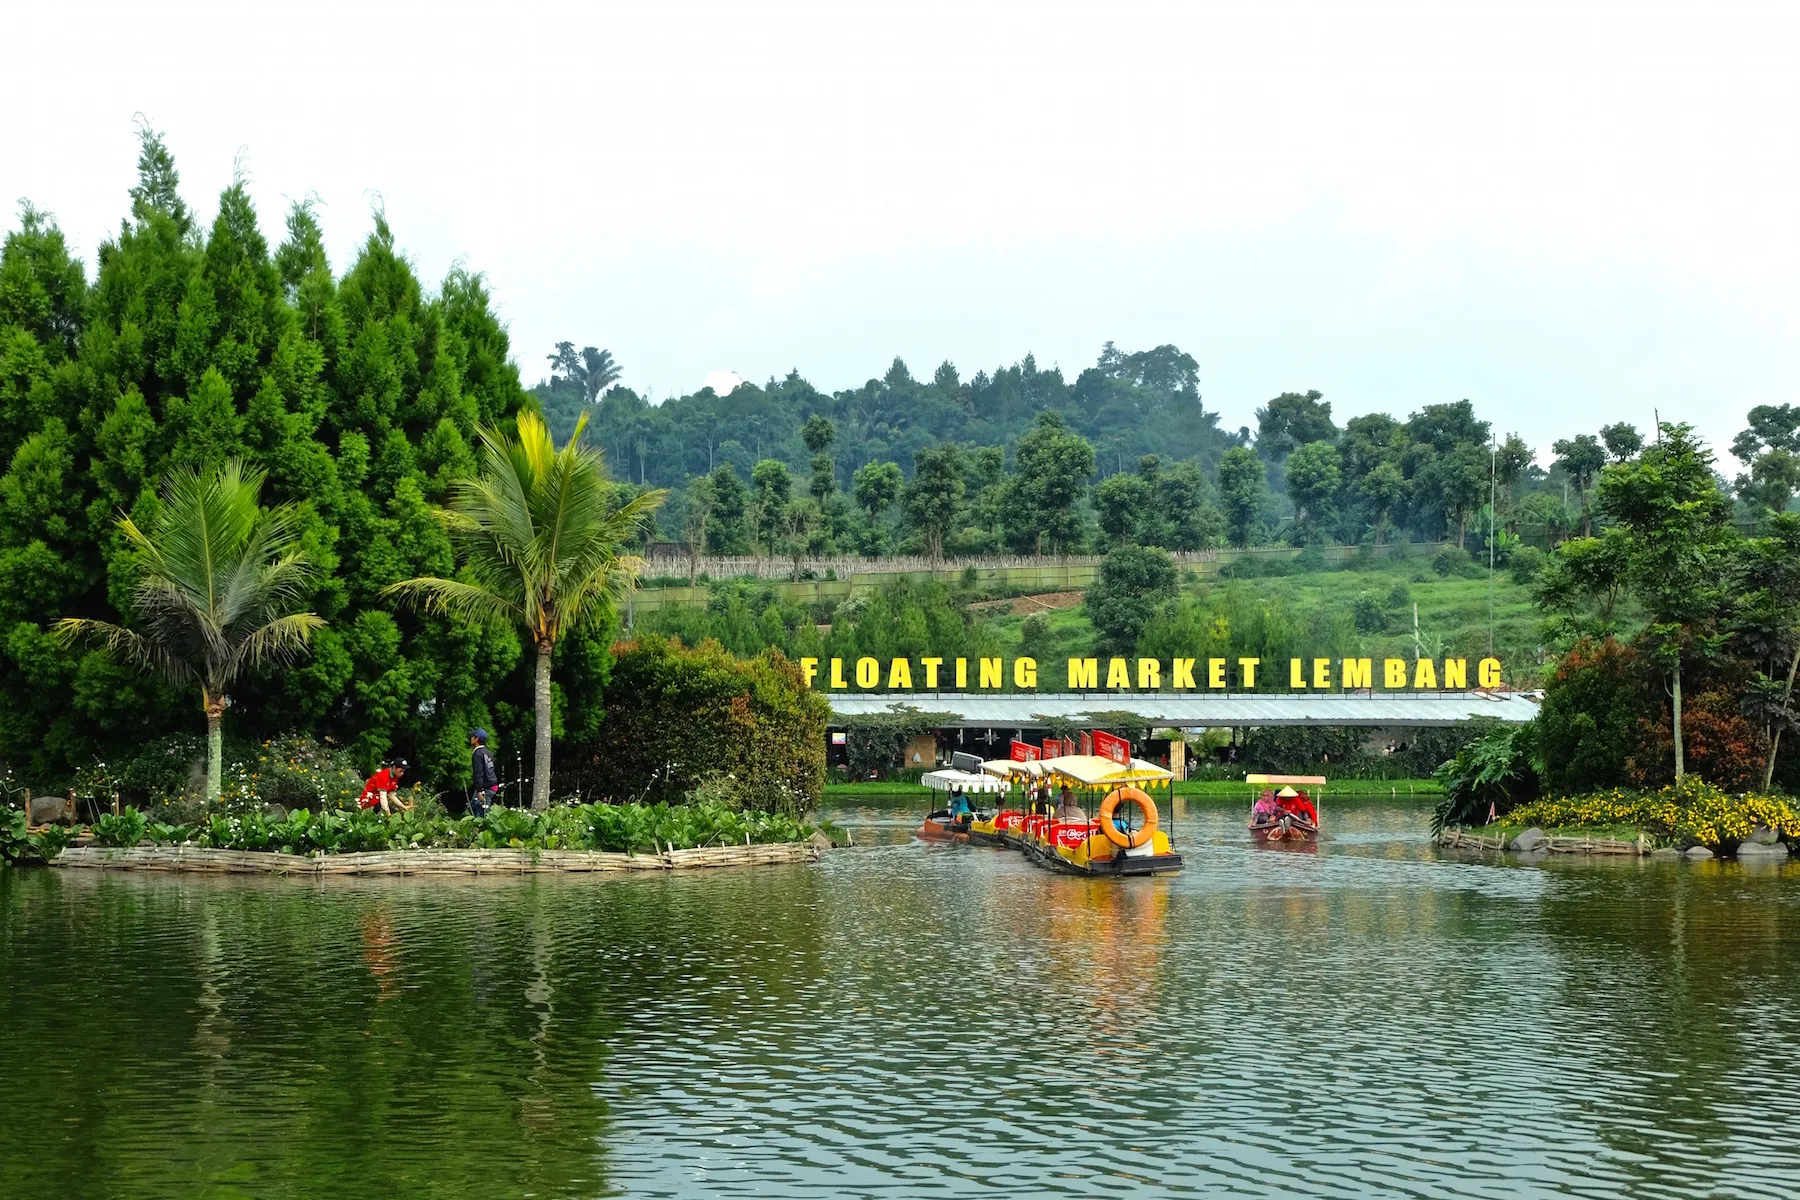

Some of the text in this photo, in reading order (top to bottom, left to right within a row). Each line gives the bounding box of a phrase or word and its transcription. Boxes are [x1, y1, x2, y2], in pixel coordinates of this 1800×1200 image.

[801, 657, 1502, 689] FLOATING MARKET LEMBANG
